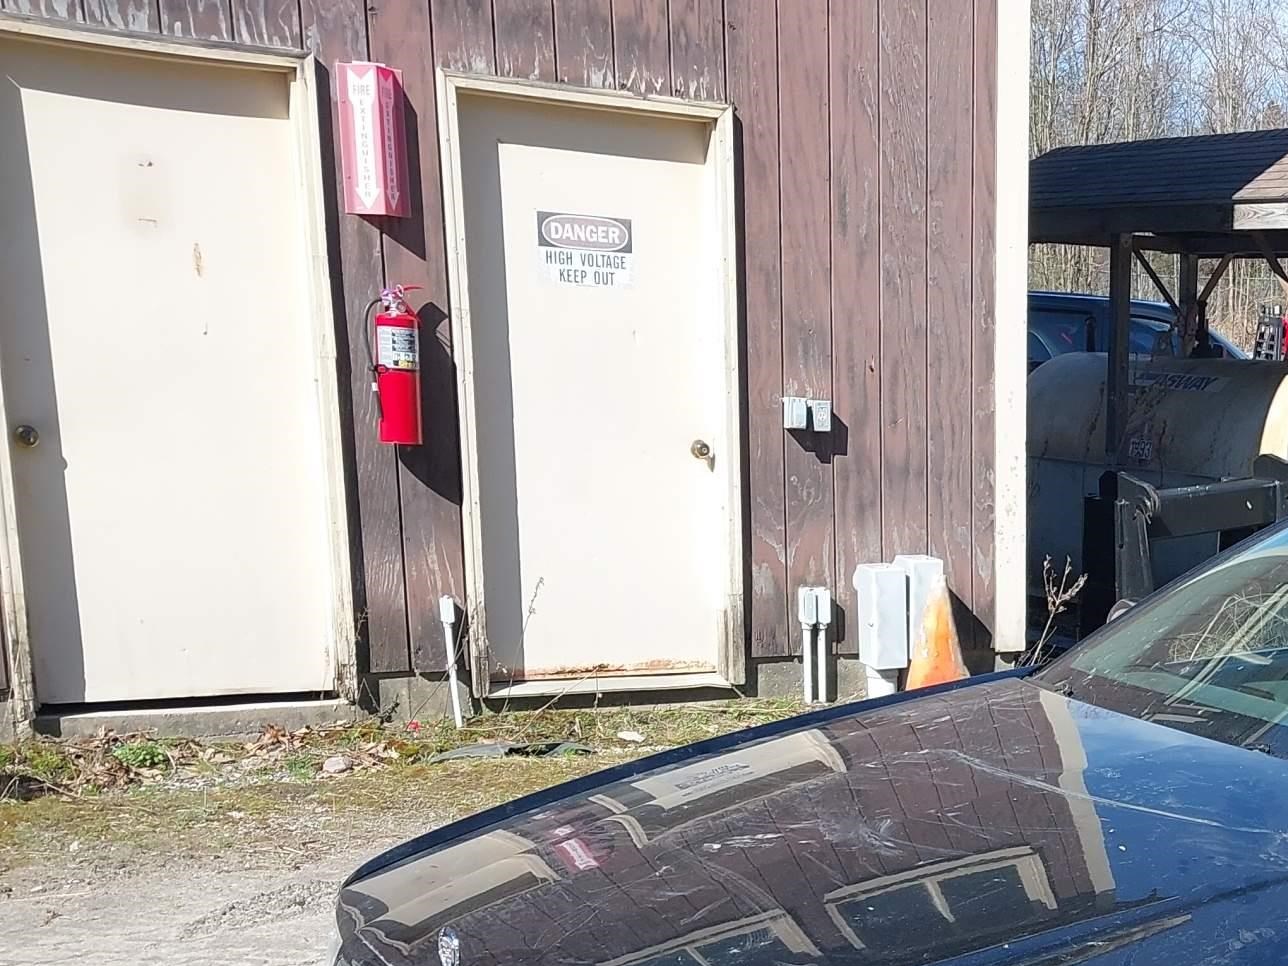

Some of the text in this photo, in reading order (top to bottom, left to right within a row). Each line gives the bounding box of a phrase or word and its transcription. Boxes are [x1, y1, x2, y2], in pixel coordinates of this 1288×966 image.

[352, 84, 371, 97] FIRE
[359, 98, 372, 199] EXTINGUISHER
[385, 100, 397, 201] EXTINGUISHER
[550, 221, 621, 244] DANGER
[545, 249, 627, 270] HIGH VOLTAGE
[559, 268, 616, 286] KEEP OUT
